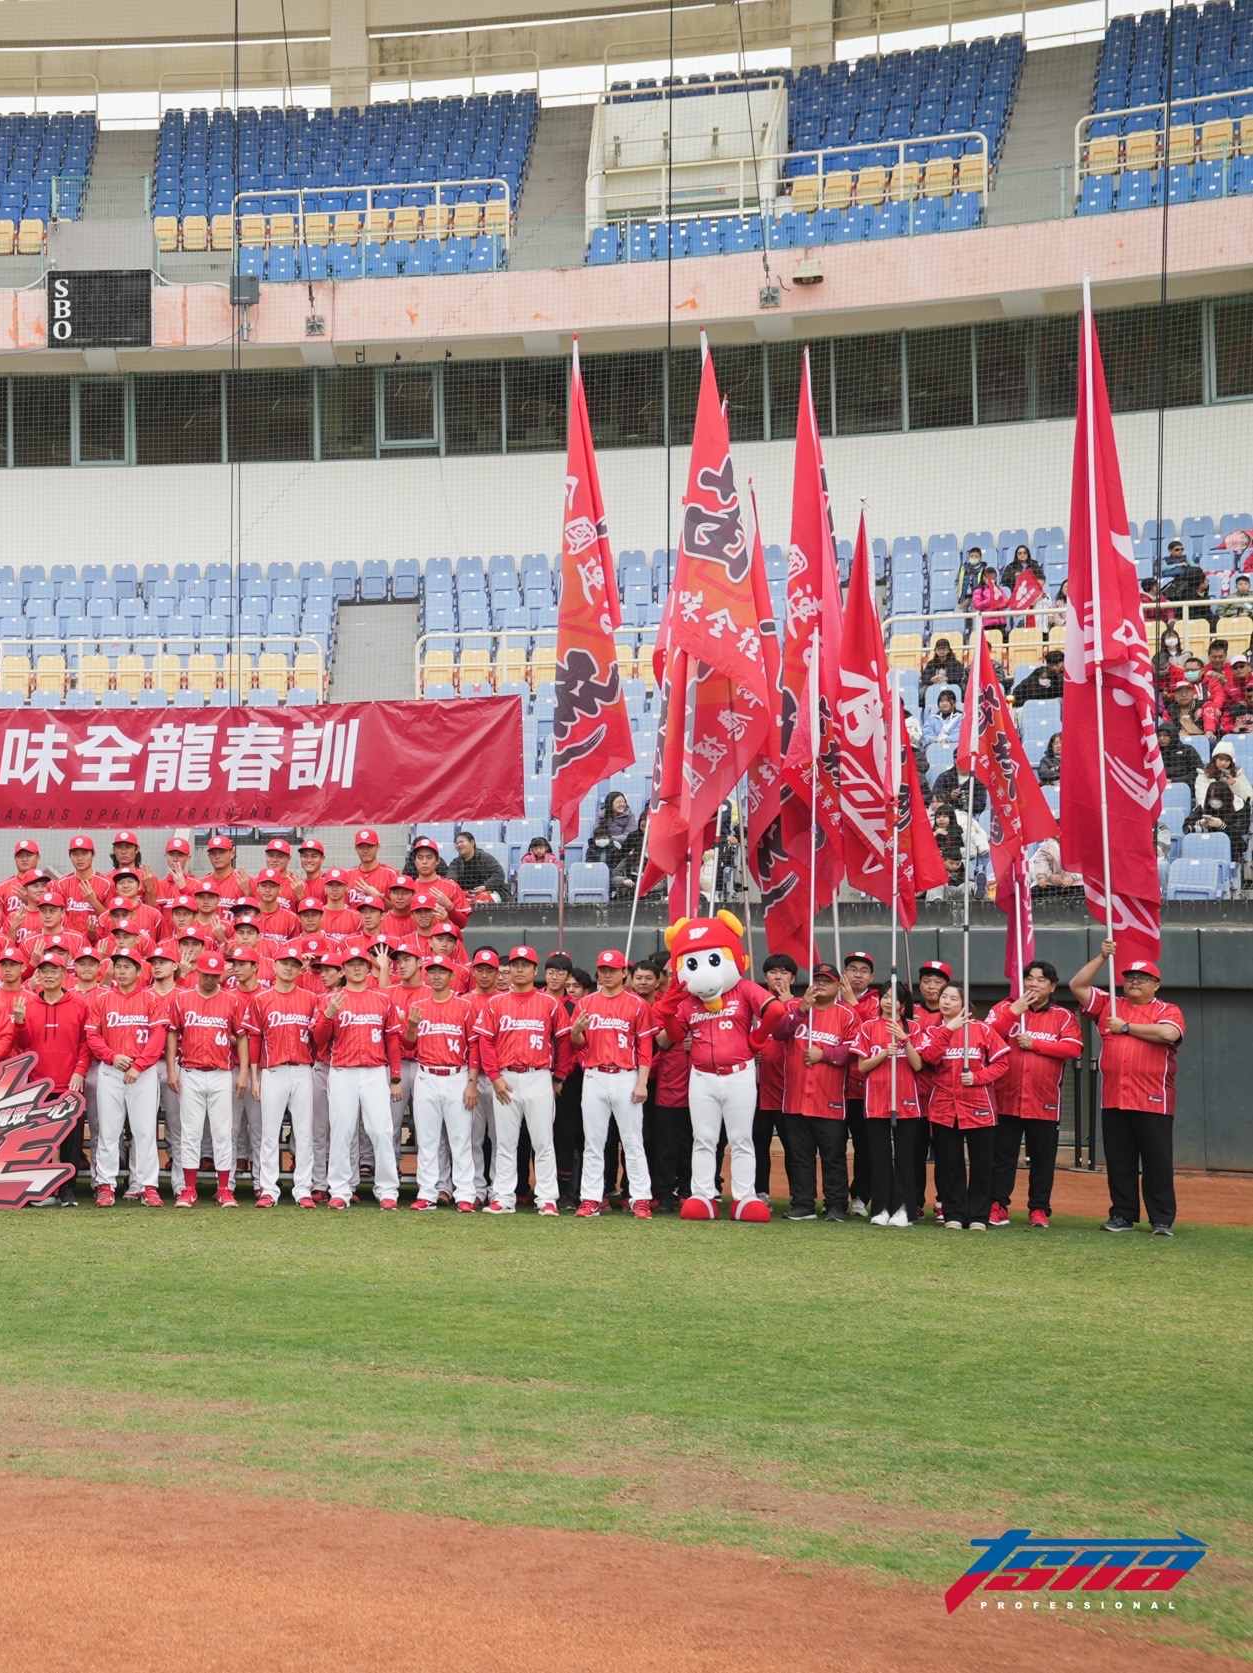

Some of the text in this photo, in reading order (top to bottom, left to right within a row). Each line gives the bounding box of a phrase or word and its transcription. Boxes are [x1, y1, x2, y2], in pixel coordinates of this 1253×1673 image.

[84, 808, 160, 821] SPRING
[175, 806, 273, 820] TRAINING
[106, 1011, 149, 1027] Dragons
[184, 1010, 228, 1028] Dragons
[338, 1010, 383, 1027] Dragons
[499, 1015, 545, 1032] Dragons
[588, 1013, 630, 1031] Dragons
[416, 1019, 462, 1036] Dragons
[215, 1031, 228, 1046] 66
[529, 1034, 544, 1050] 95
